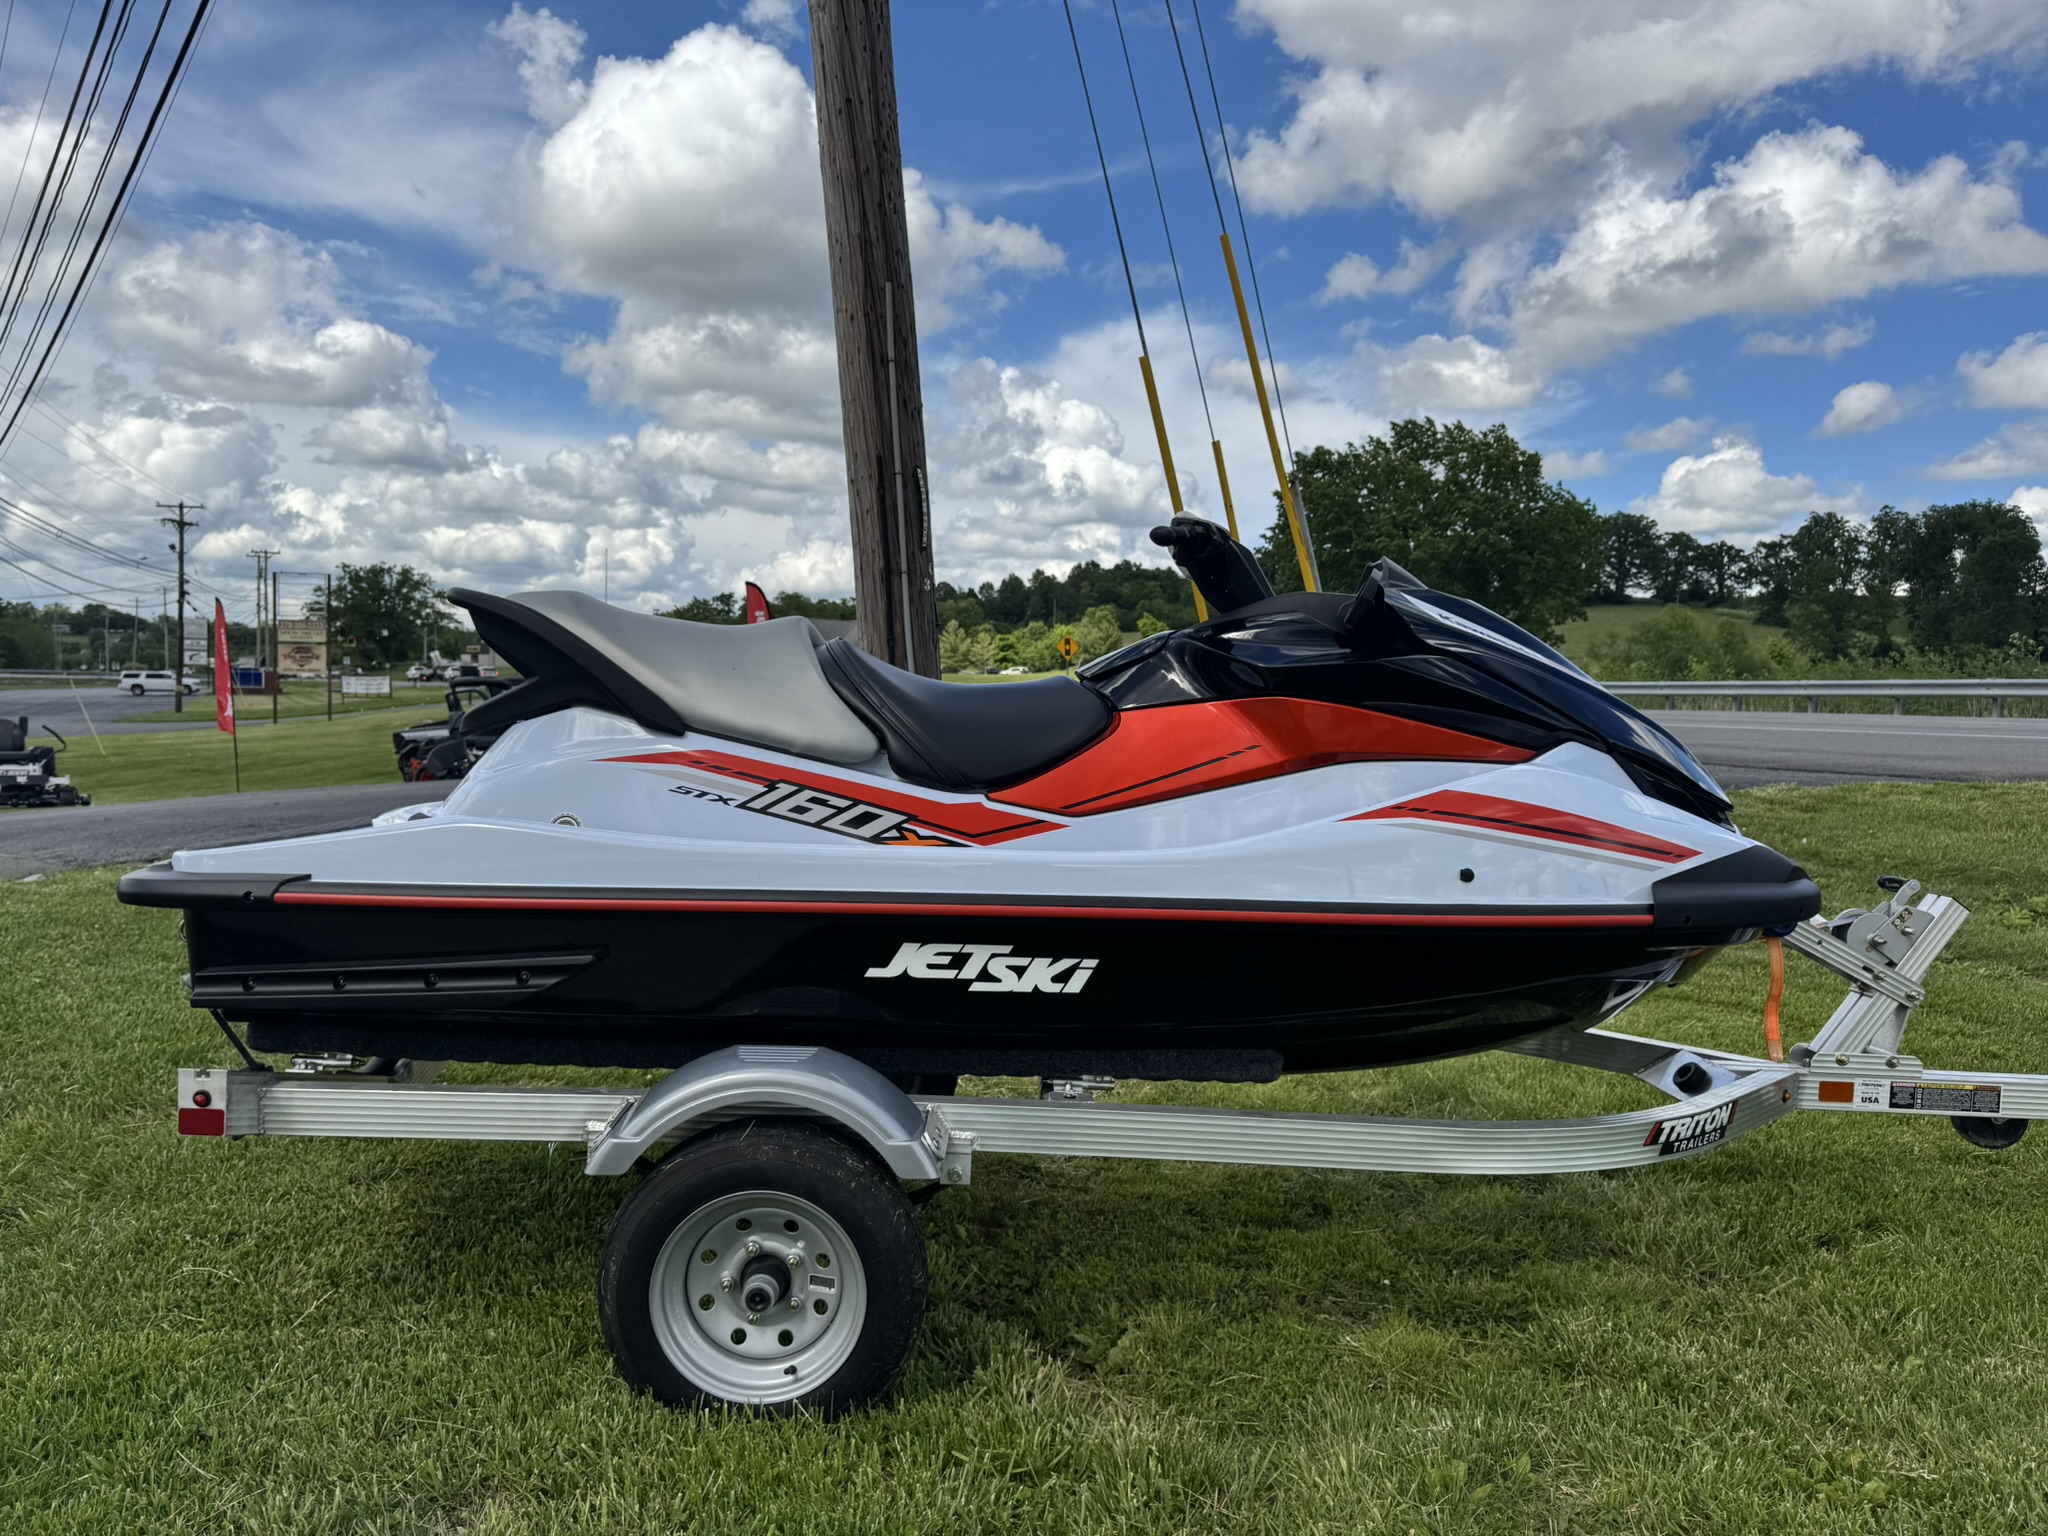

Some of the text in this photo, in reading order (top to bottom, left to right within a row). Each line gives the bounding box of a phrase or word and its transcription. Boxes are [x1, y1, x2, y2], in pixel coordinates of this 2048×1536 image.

[668, 785, 738, 807] STX
[1861, 1096, 1880, 1104] USA
[1658, 1102, 1733, 1144] TRITON
[1673, 1130, 1721, 1153] TRAILERS
